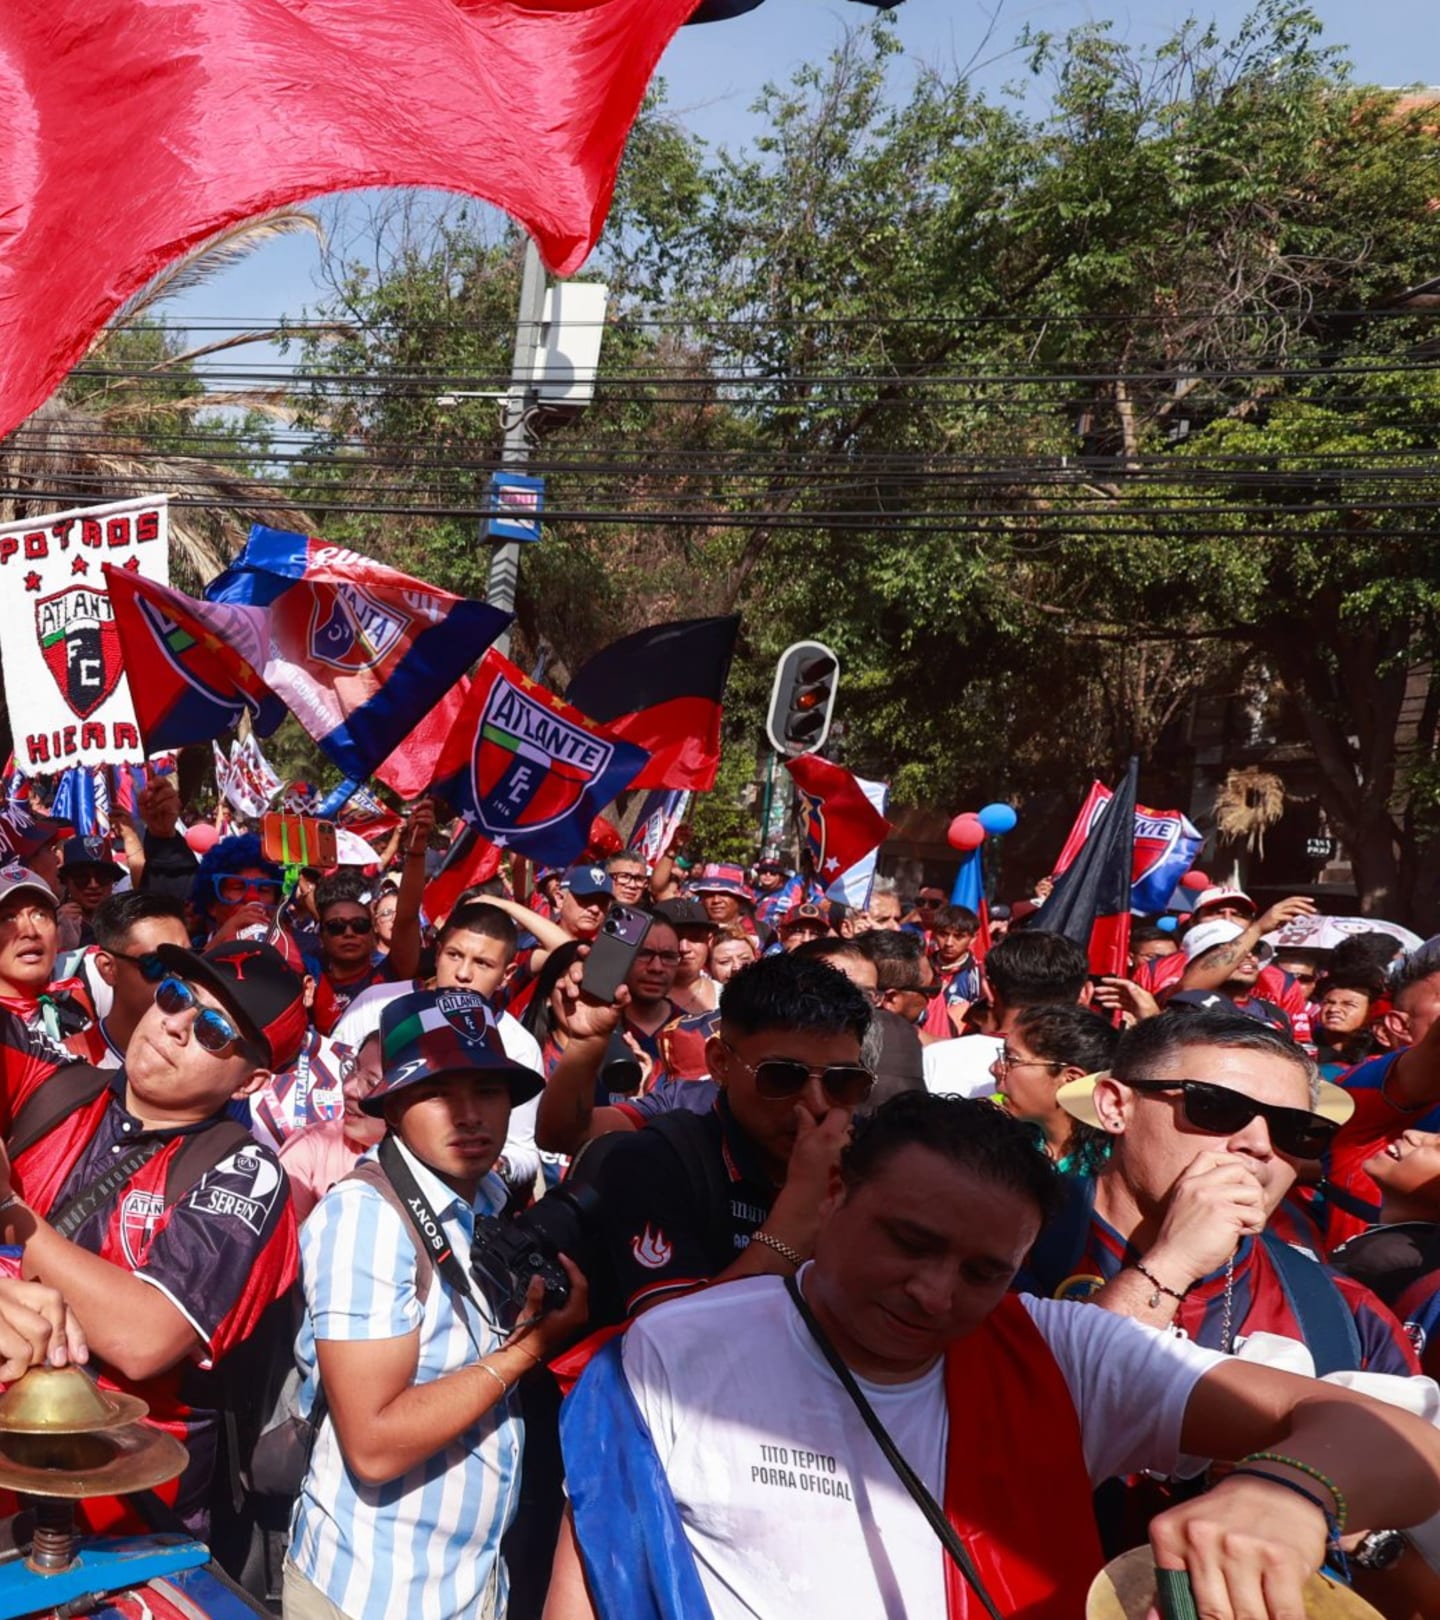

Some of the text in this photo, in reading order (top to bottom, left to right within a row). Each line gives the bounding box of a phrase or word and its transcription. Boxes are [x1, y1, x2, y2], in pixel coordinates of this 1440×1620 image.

[42, 593, 112, 637] ATLANT
[26, 721, 139, 765] HIERR
[492, 690, 601, 768] ATLANTE
[98, 1154, 146, 1197] JORDAN
[408, 1196, 445, 1250] SONY
[759, 1444, 836, 1474] TITO TEPITO
[751, 1465, 852, 1502] PORRA OFICIAL
